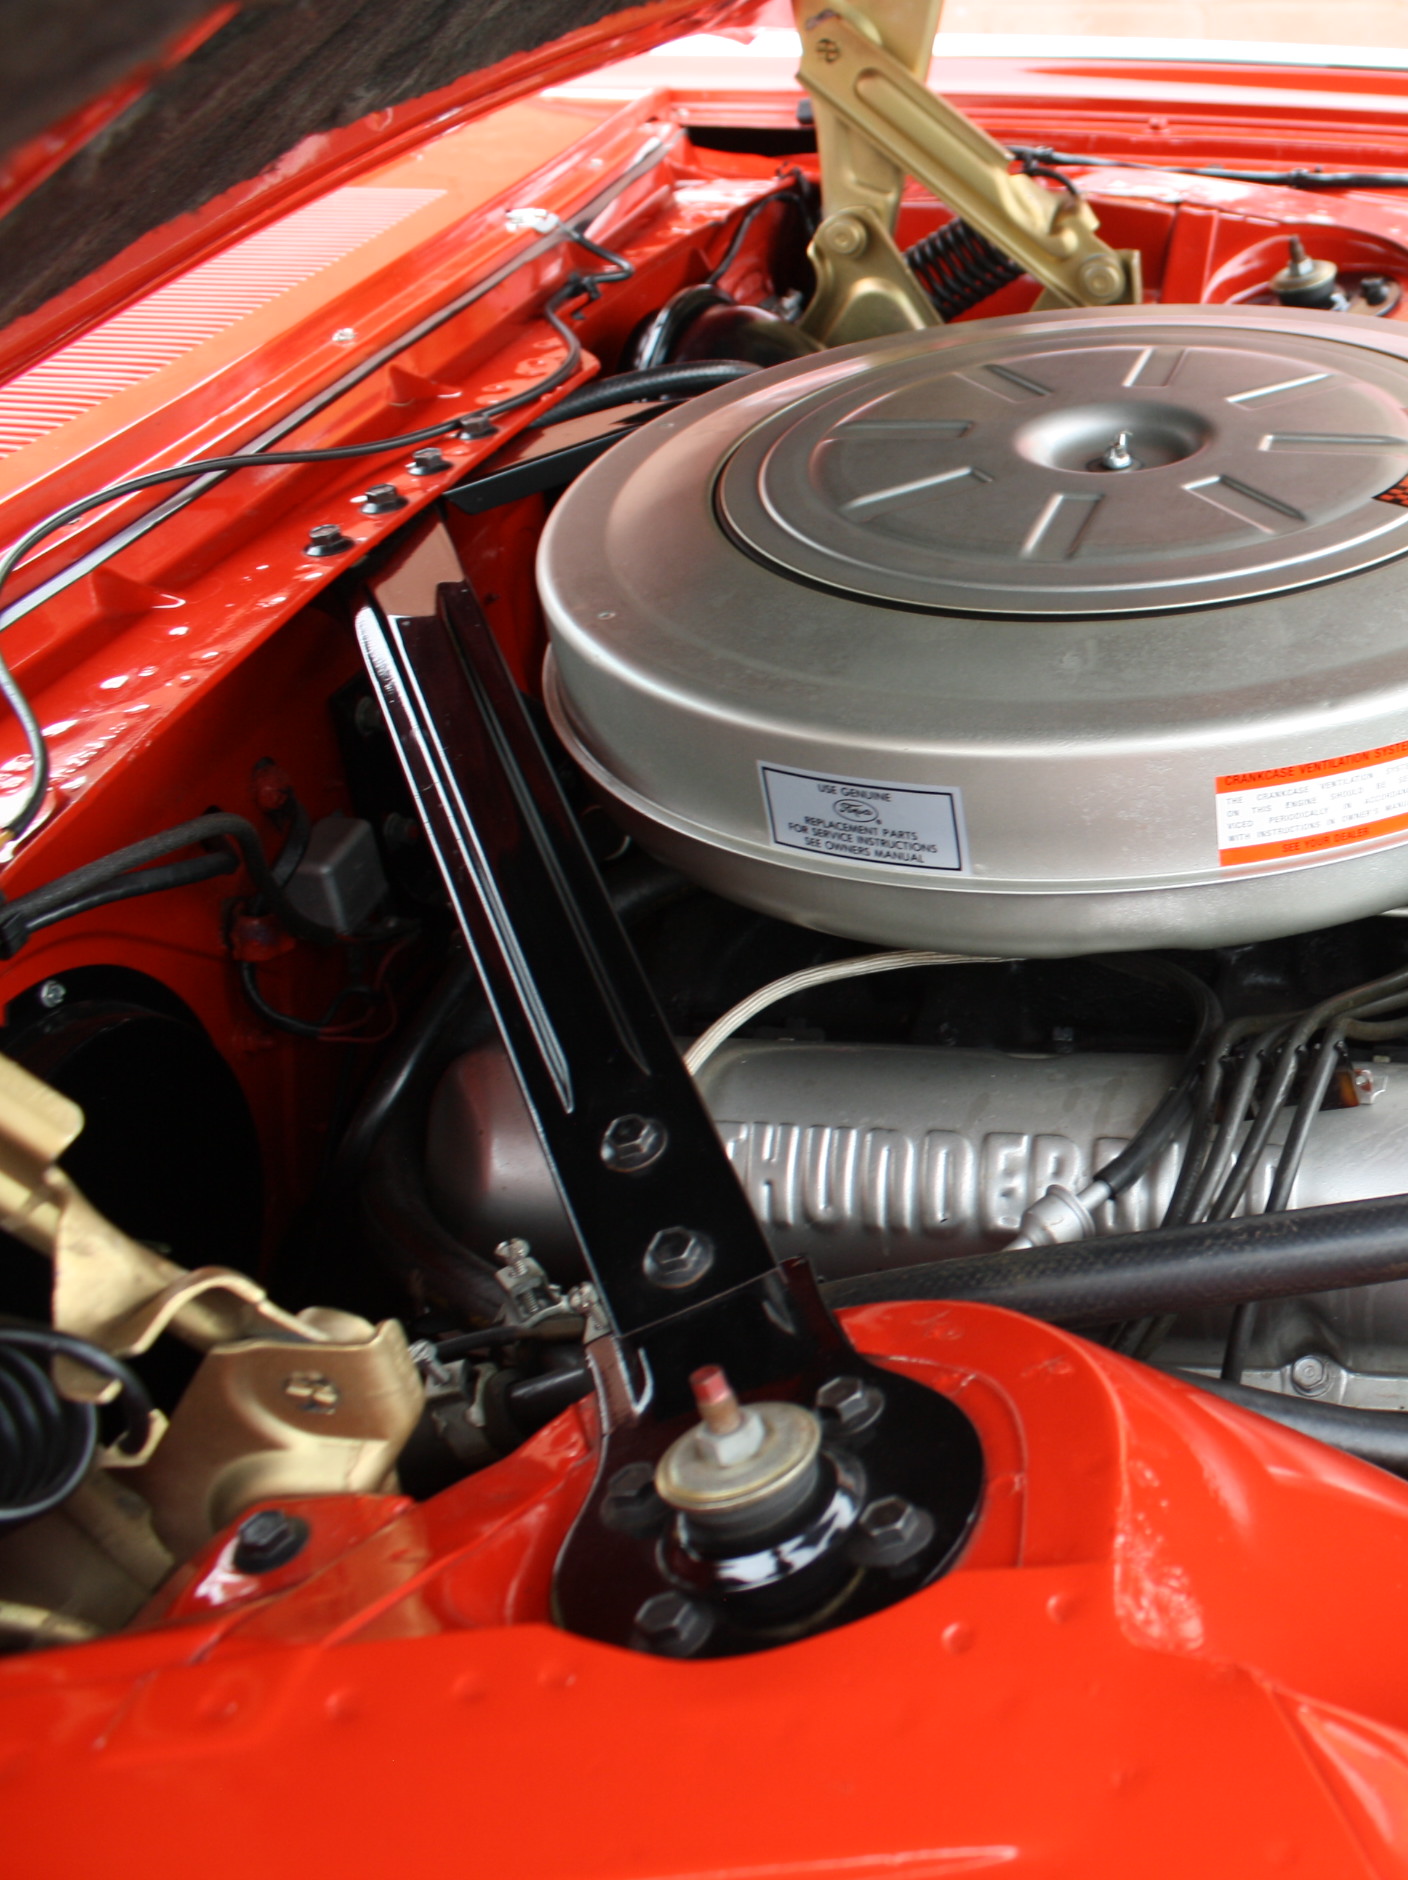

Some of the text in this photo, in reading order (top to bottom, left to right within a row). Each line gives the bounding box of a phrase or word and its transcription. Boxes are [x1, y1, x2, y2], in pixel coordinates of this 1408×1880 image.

[1224, 766, 1295, 786] CRANKCASE
[1299, 751, 1369, 775] VENTILATION
[817, 783, 892, 802] USE GENUINE
[1227, 796, 1243, 805] THE
[1256, 785, 1309, 801] CRANKCASE
[1321, 773, 1374, 790] VENTILATION
[1227, 808, 1240, 817] ON
[1252, 804, 1272, 814] THIS
[1285, 797, 1317, 809] ENGINE
[1330, 787, 1364, 801] SHOULD
[1376, 781, 1386, 790] BE
[804, 815, 918, 841] REPLACEMENT PARTS
[1227, 819, 1254, 830] VICED
[1269, 807, 1329, 824] PERIODICALLY
[1343, 801, 1352, 809] IN
[1228, 832, 1251, 842] WITH
[1257, 821, 1320, 838] INSTRUCTIONS
[1326, 817, 1336, 825] IN
[788, 821, 938, 854] FOR SERVICE INSTRUCTIONS
[804, 837, 925, 864] SEE OWNERS MANUAL
[1282, 827, 1370, 853] SEE YOUR DEALER
